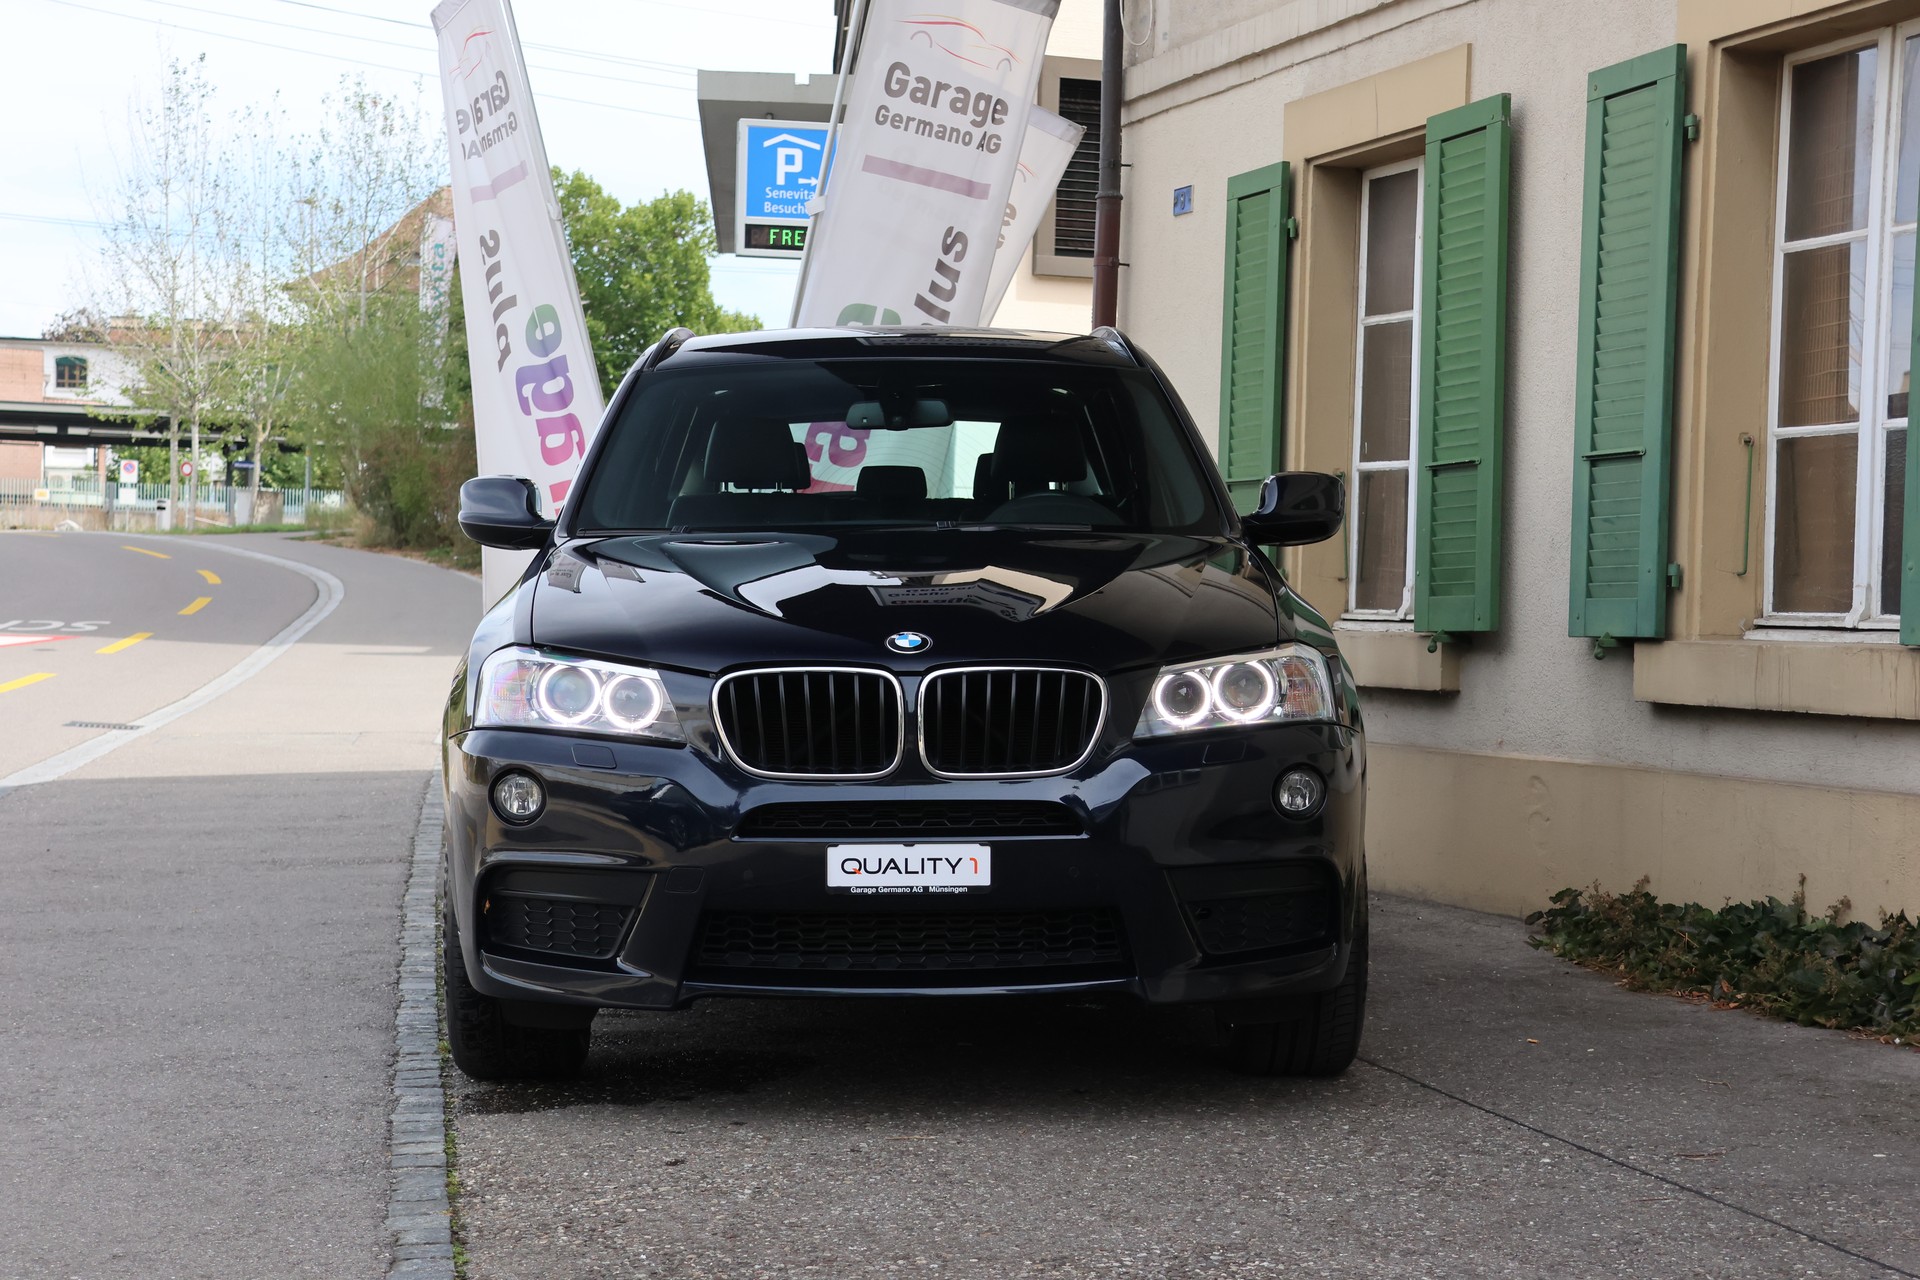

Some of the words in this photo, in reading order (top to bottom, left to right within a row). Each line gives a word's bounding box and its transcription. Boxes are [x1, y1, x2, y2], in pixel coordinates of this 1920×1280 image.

[884, 61, 1009, 128] Garage
[875, 104, 973, 147] Germano
[976, 131, 1002, 154] AG
[776, 147, 803, 185] P
[765, 187, 816, 200] Senevita
[769, 228, 808, 247] FRE
[914, 226, 969, 326] lus
[841, 857, 963, 874] QUALITY
[969, 857, 978, 874] 1
